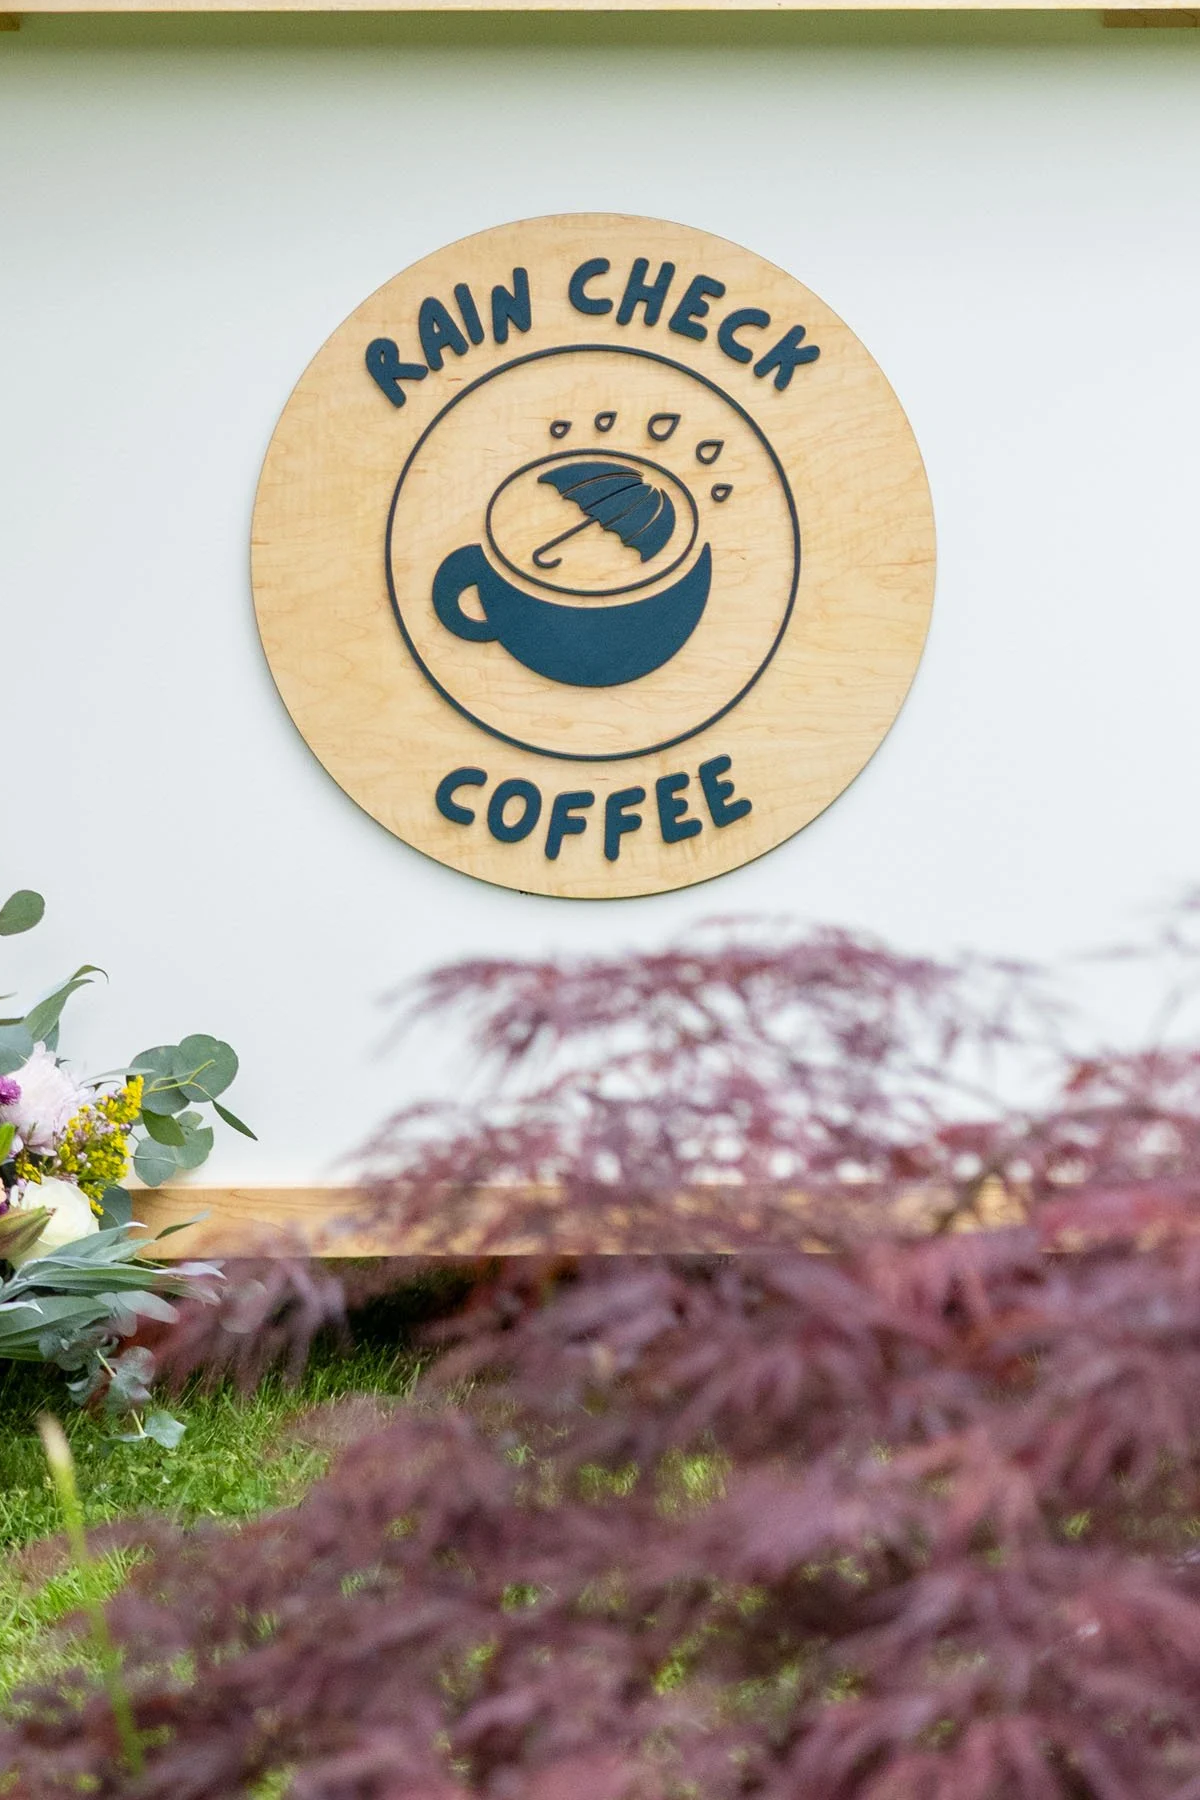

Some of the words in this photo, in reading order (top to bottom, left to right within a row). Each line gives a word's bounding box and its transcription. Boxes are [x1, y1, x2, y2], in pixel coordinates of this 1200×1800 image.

[365, 267, 532, 408] RAIN
[567, 257, 821, 391] CHECK
[434, 753, 752, 861] COFFEE
